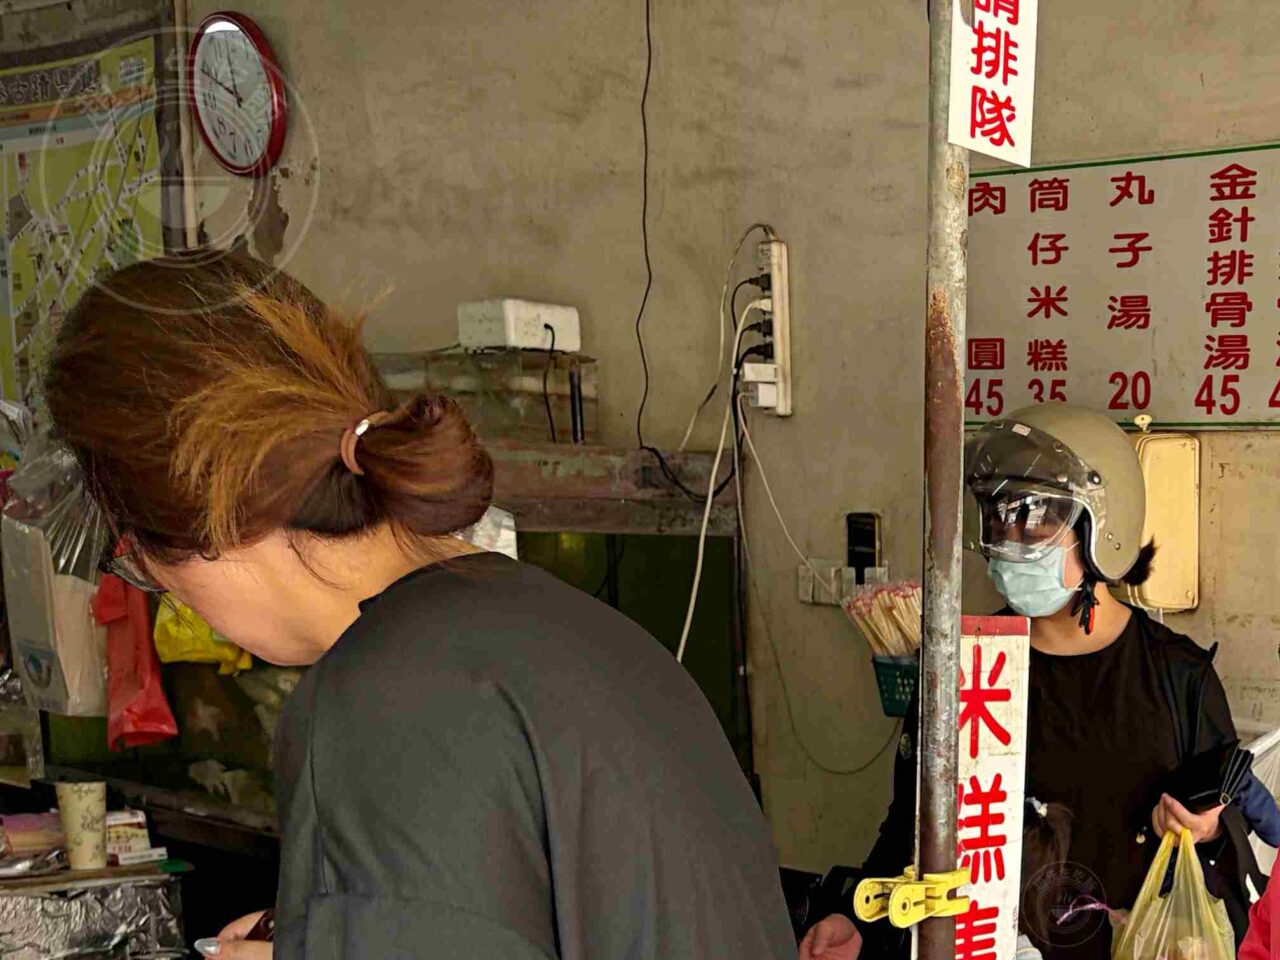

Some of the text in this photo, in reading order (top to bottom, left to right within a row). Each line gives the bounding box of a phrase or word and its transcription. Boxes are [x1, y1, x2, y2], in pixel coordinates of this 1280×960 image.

[1027, 177, 1070, 372] 筒仔米糕
[1107, 171, 1155, 411] 丸子湯 20
[1194, 163, 1258, 416] 金針排骨湯 45
[965, 379, 1004, 416] 45
